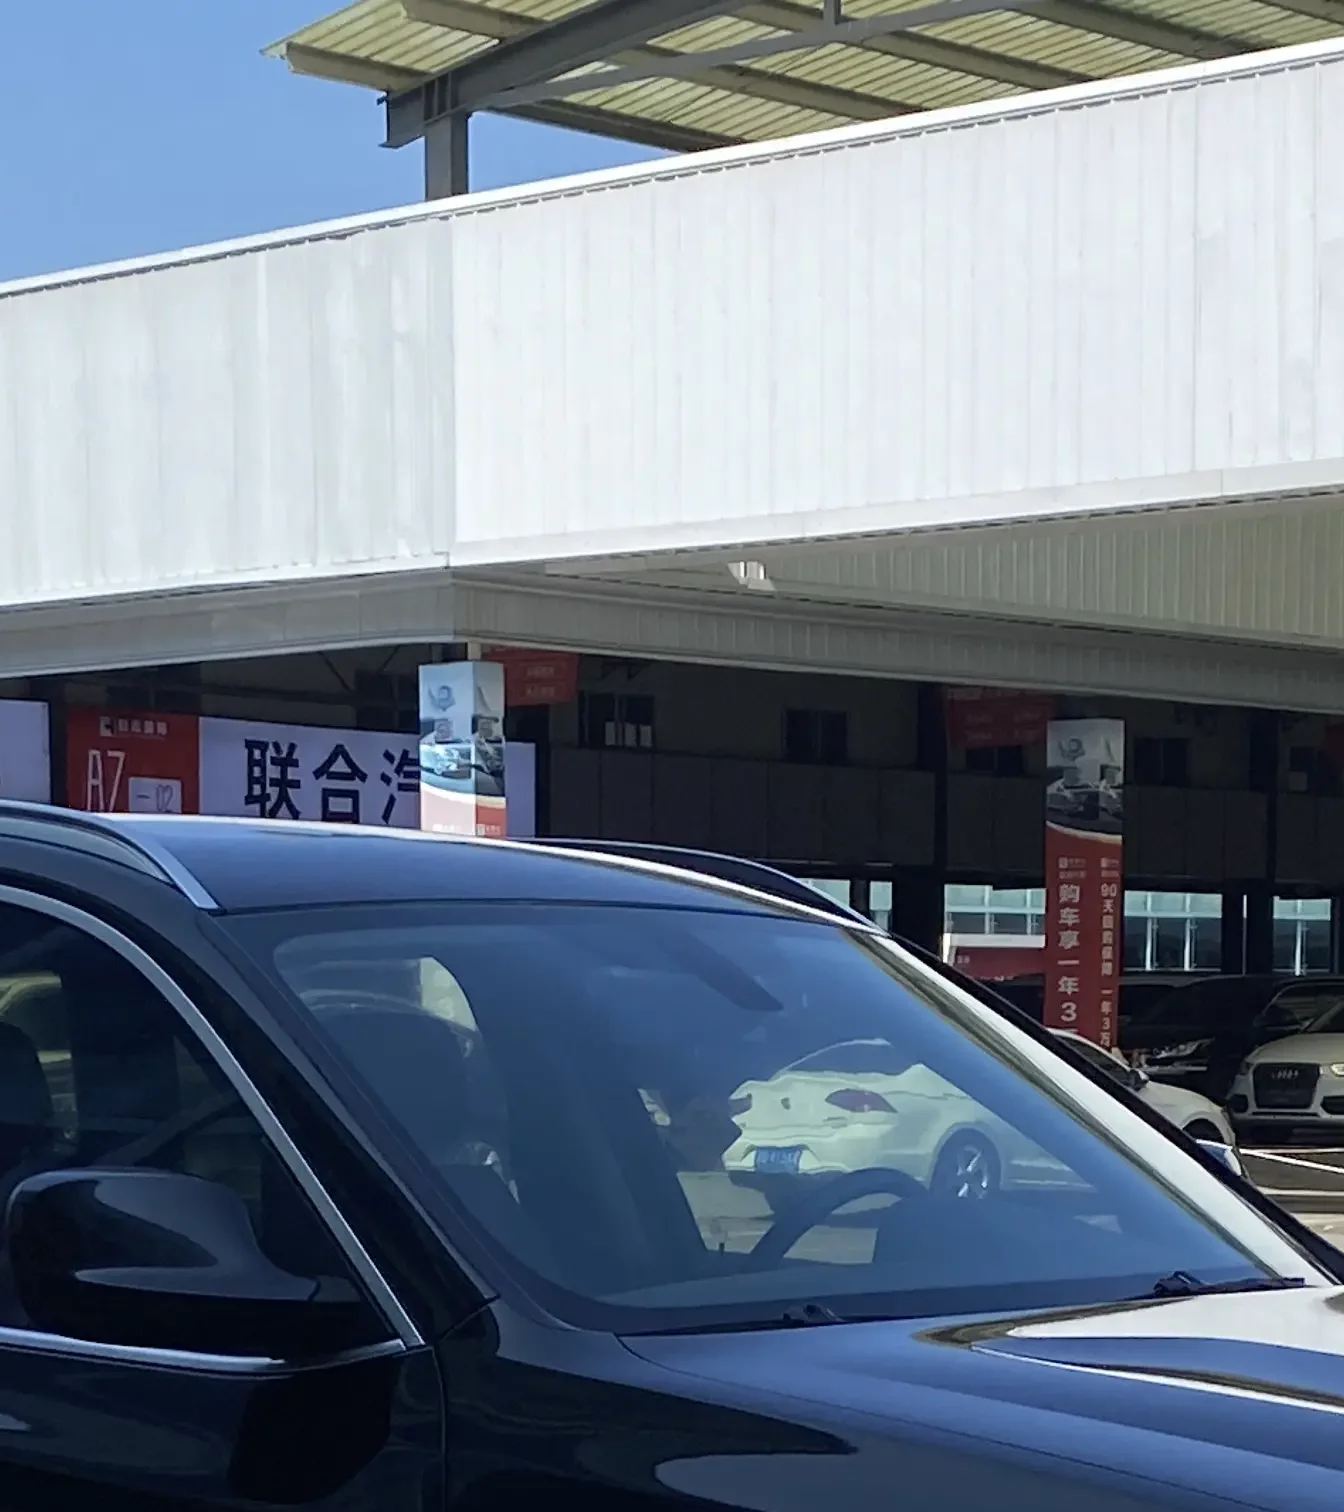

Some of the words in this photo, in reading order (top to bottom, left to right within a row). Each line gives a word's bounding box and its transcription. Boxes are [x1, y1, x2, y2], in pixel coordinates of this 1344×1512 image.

[1057, 883, 1081, 1033] 购车享一年3
